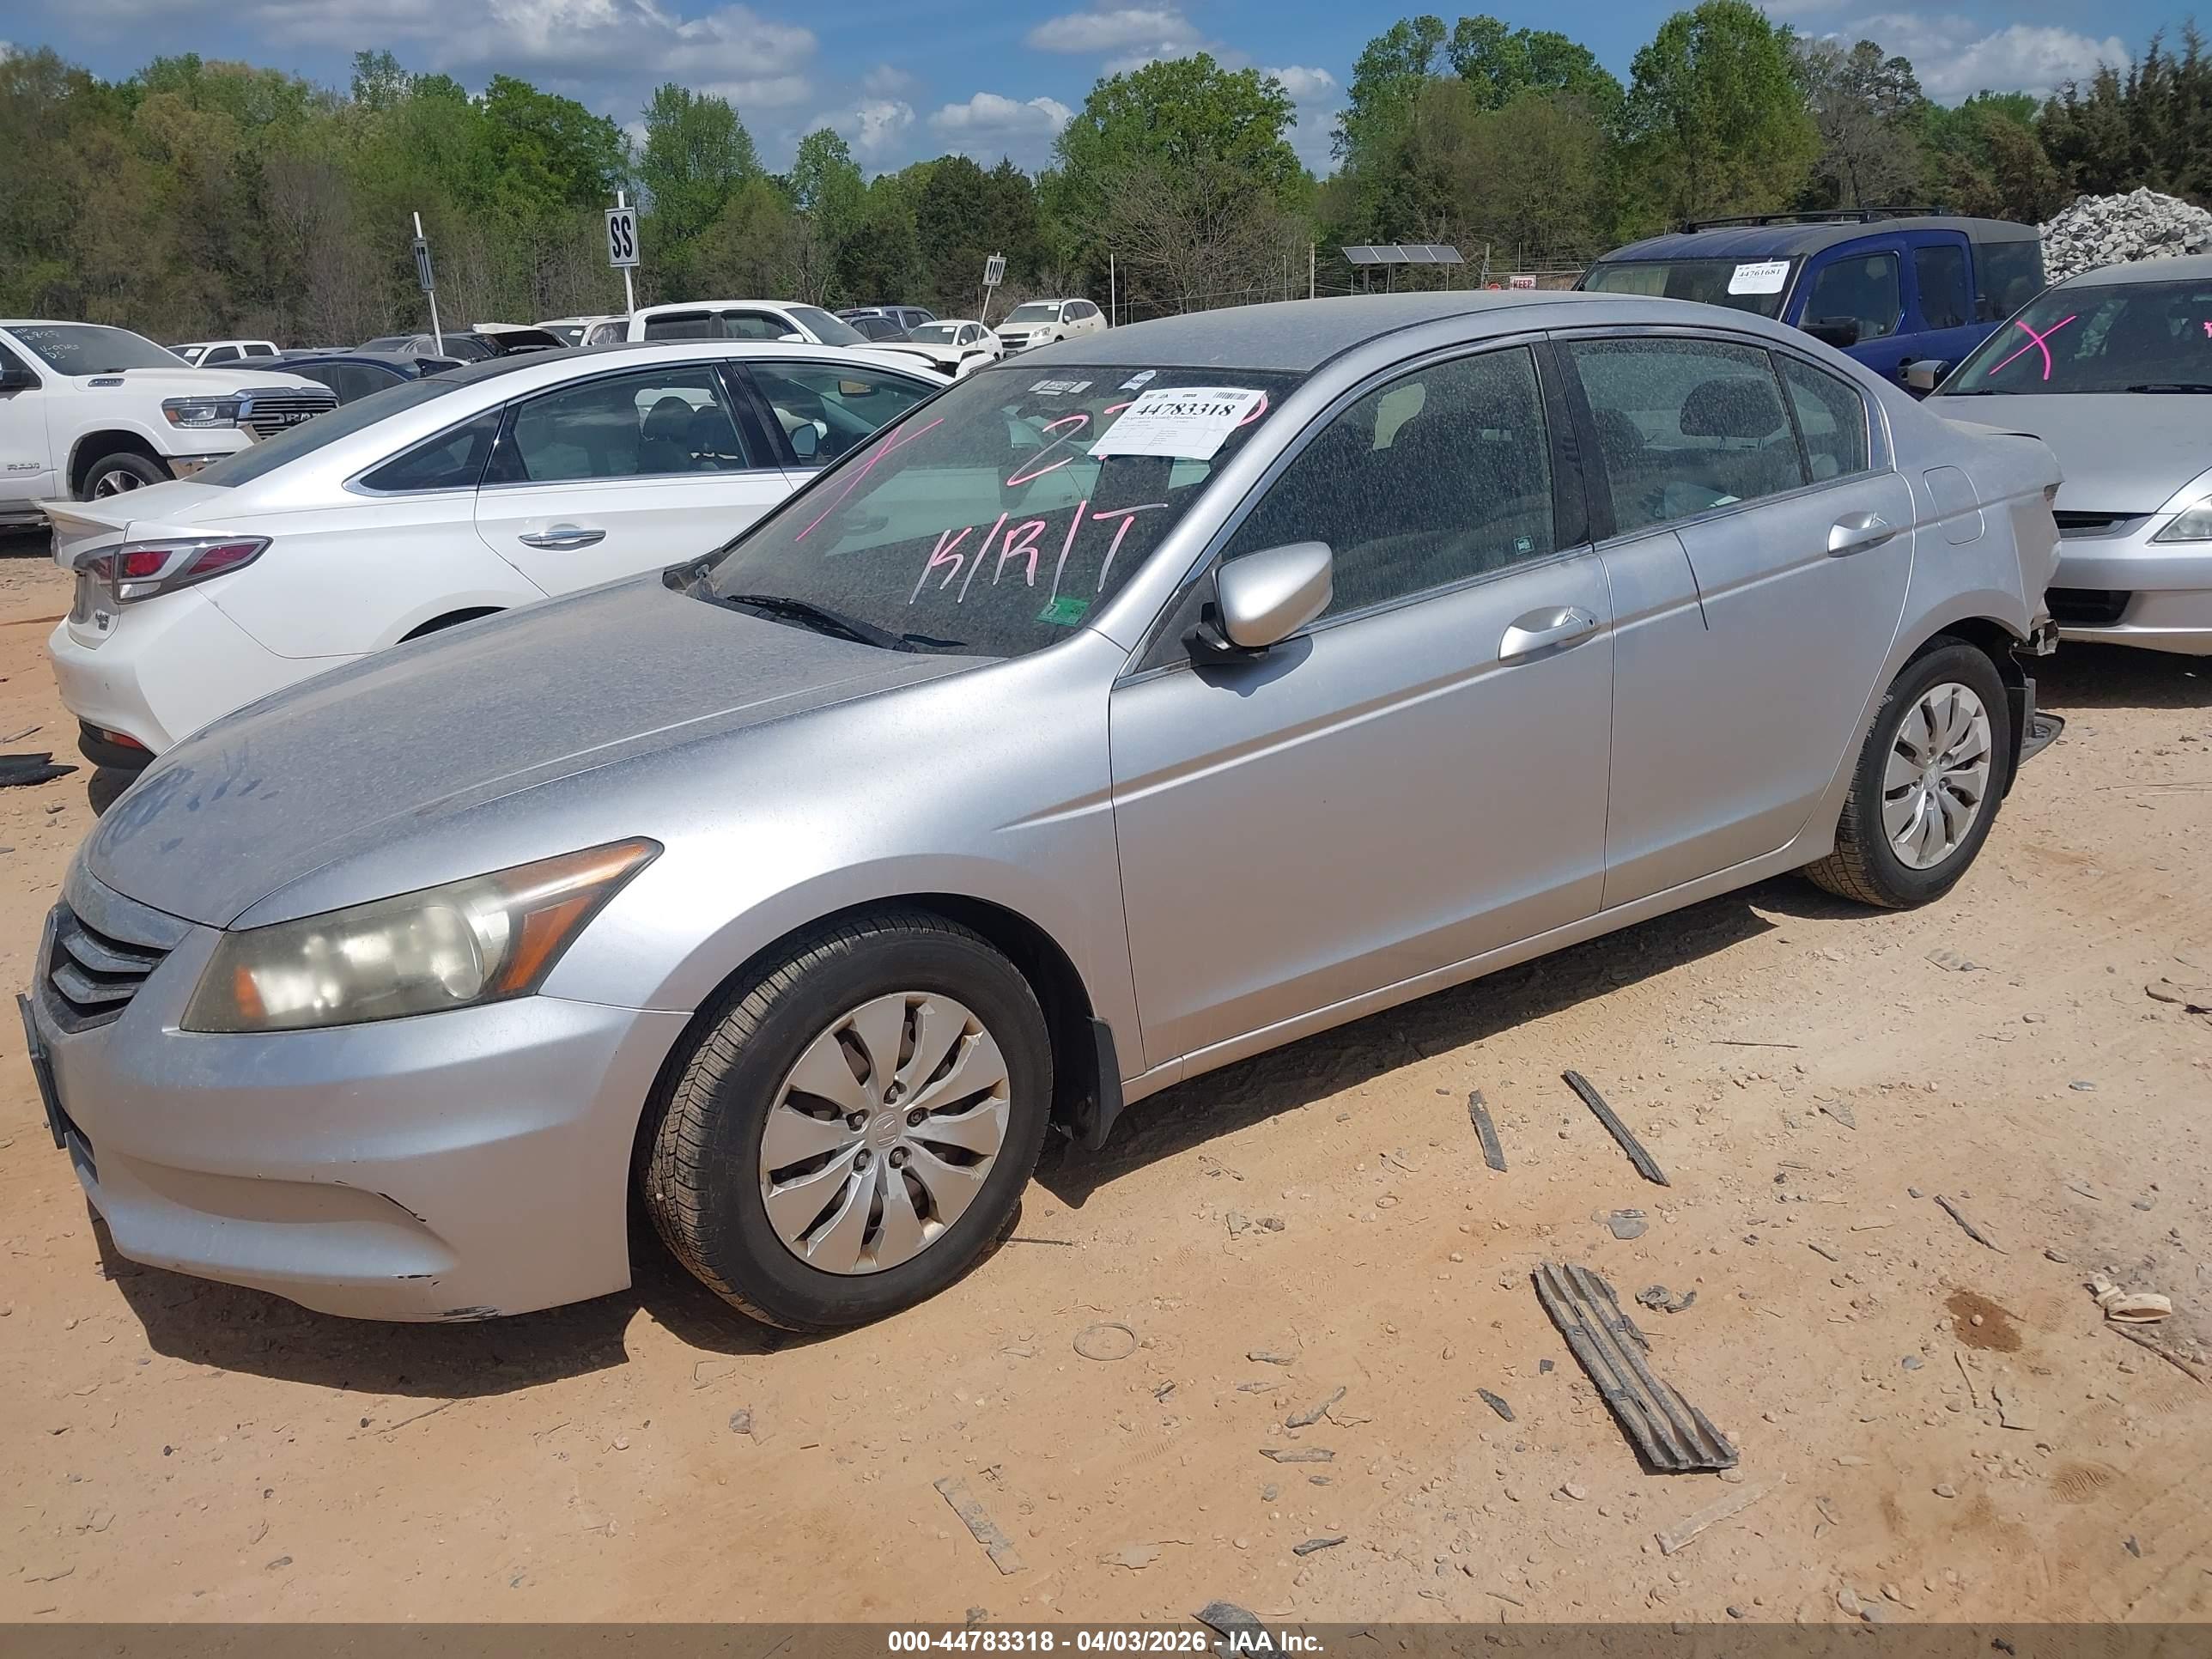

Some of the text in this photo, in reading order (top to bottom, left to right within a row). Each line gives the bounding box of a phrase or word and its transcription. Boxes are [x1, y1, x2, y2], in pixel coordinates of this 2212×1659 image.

[611, 215, 633, 258] SS
[1513, 279, 1533, 289] KEEP
[1136, 403, 1237, 416] 44783318
